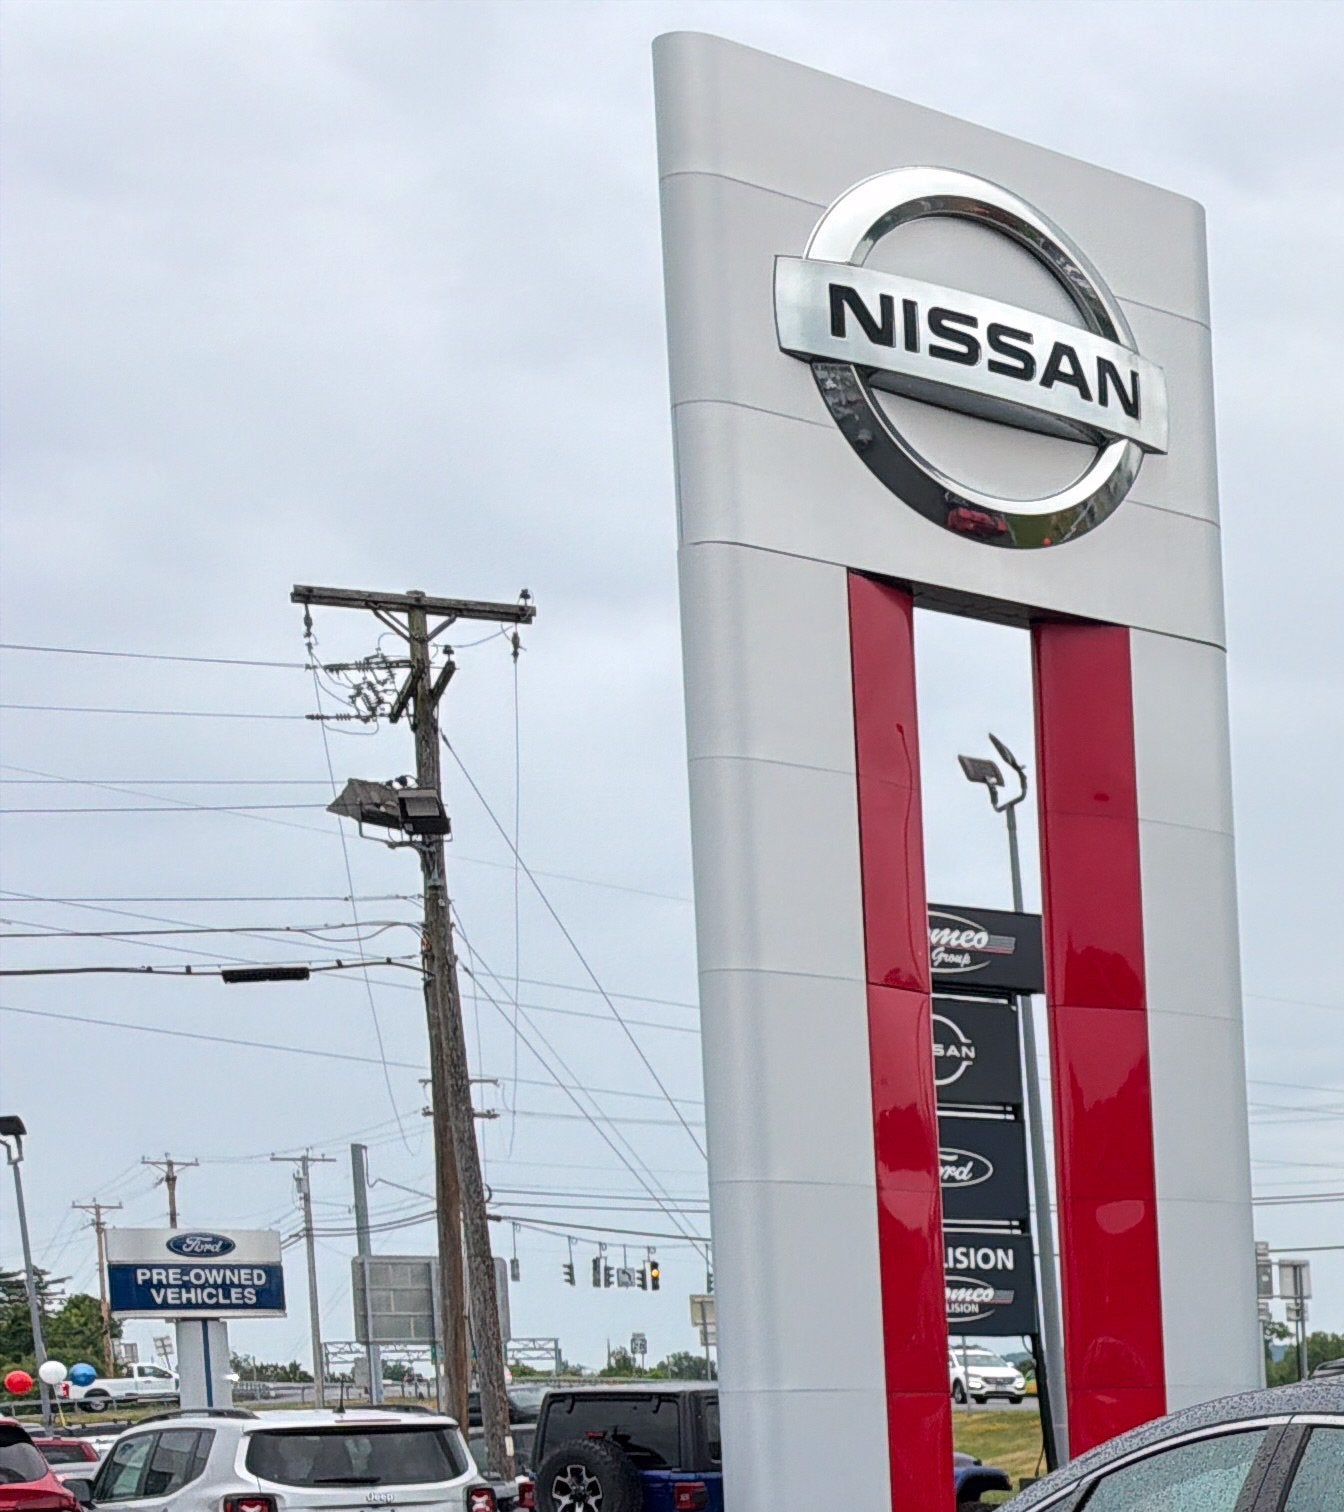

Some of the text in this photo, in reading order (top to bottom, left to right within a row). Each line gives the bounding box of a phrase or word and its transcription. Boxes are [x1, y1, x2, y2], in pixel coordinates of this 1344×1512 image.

[828, 283, 1142, 422] NISSAN
[931, 946, 971, 967] Group
[932, 1043, 976, 1059] SAN
[182, 1236, 222, 1253] Ford
[944, 1247, 1014, 1270] ISION
[136, 1268, 266, 1285] PRE-OWNED
[151, 1288, 257, 1305] VEHICLES
